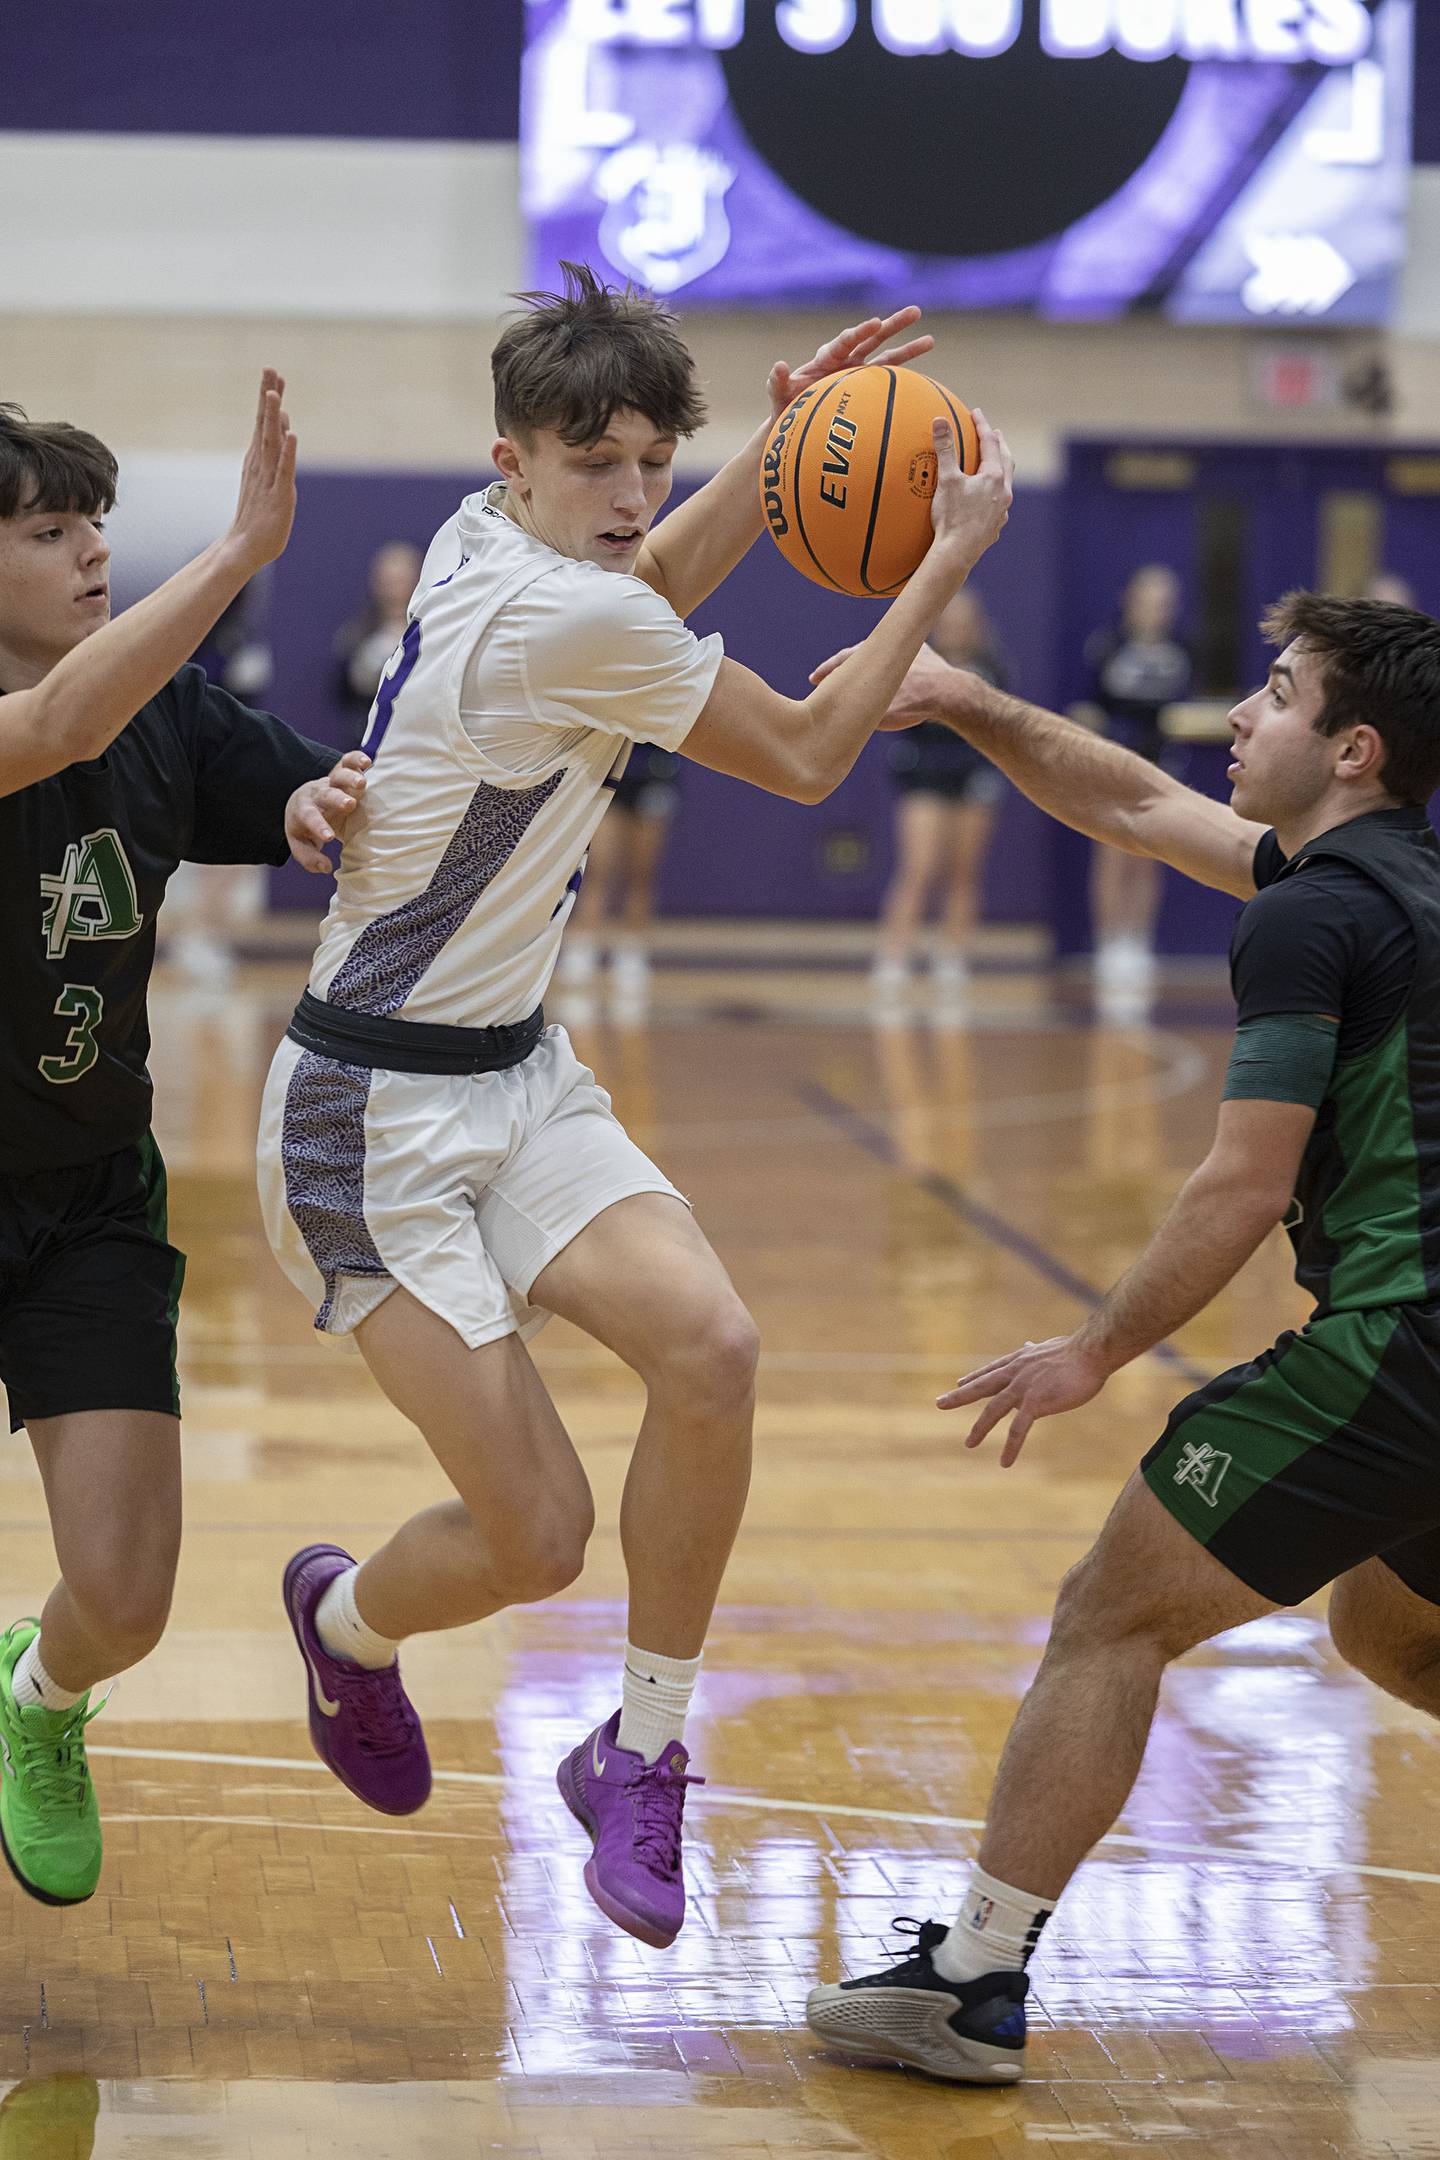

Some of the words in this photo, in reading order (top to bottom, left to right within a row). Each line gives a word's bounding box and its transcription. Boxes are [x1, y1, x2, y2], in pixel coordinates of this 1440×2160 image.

[836, 390, 852, 415] NXT
[820, 414, 858, 511] EVO
[37, 982, 104, 1084] 3
